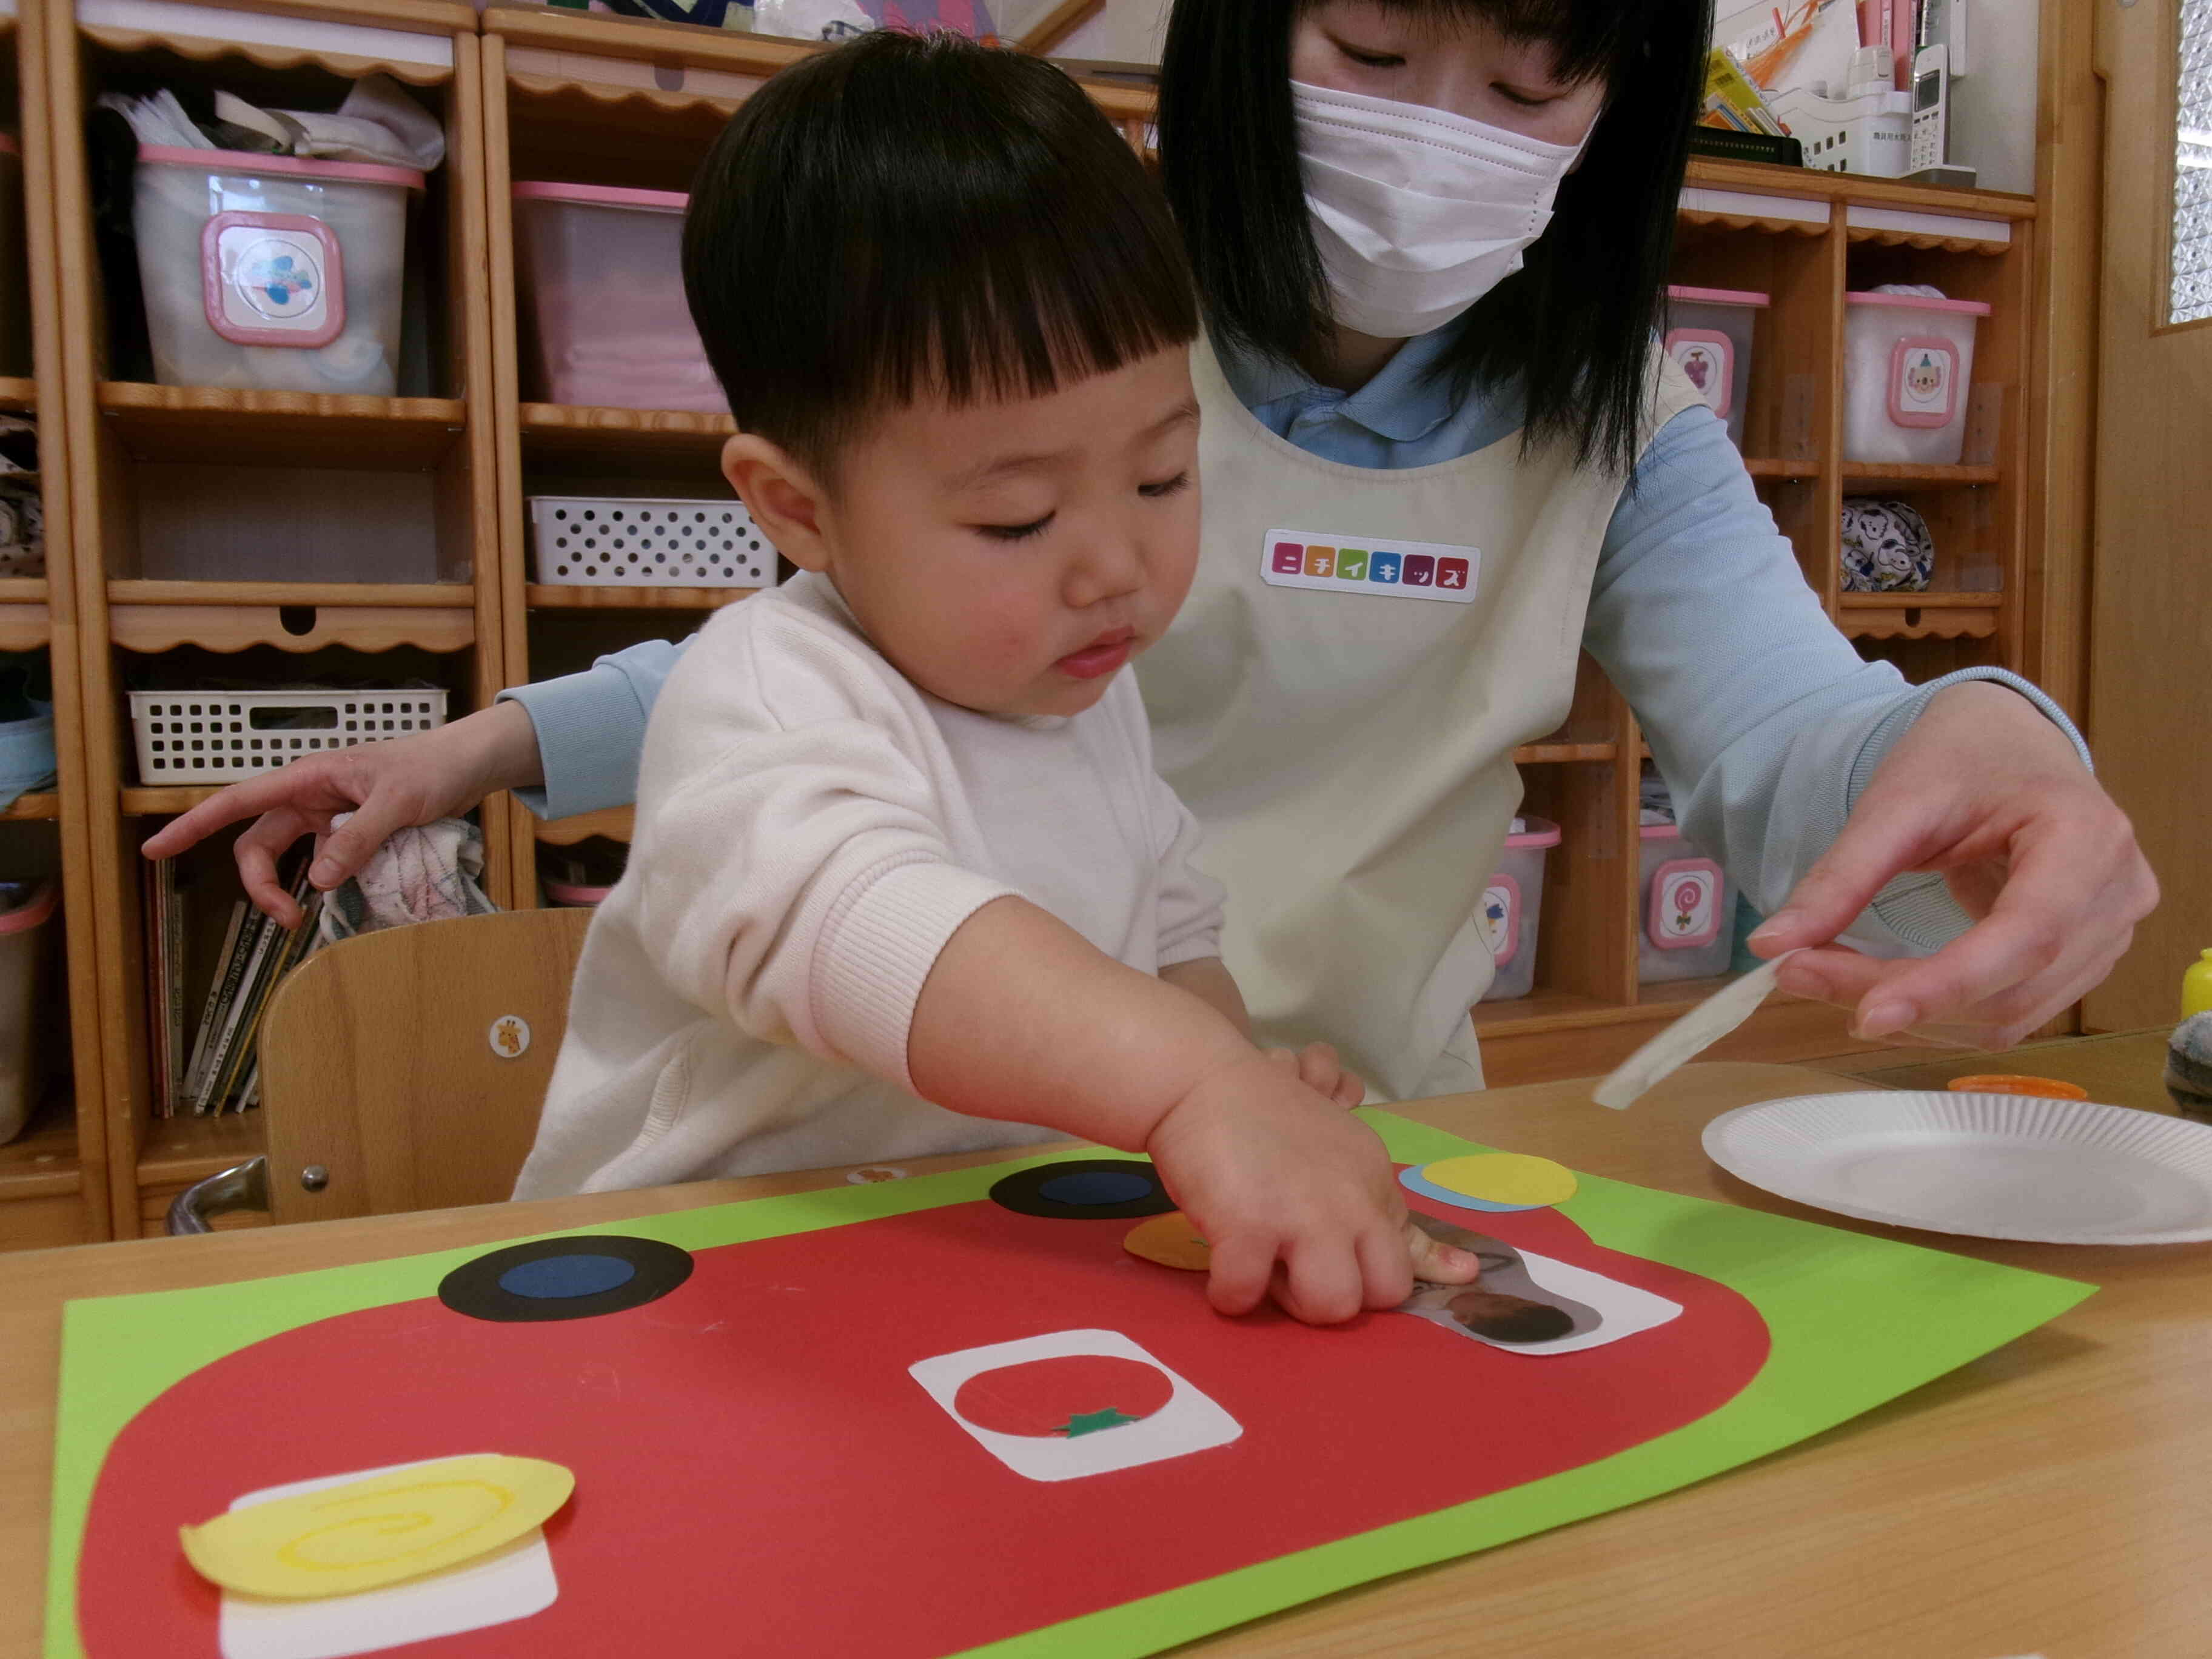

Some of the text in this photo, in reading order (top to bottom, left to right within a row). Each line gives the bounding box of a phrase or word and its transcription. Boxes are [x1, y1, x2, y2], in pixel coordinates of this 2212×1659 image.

[1281, 554, 1466, 588] ニチイキッズ
